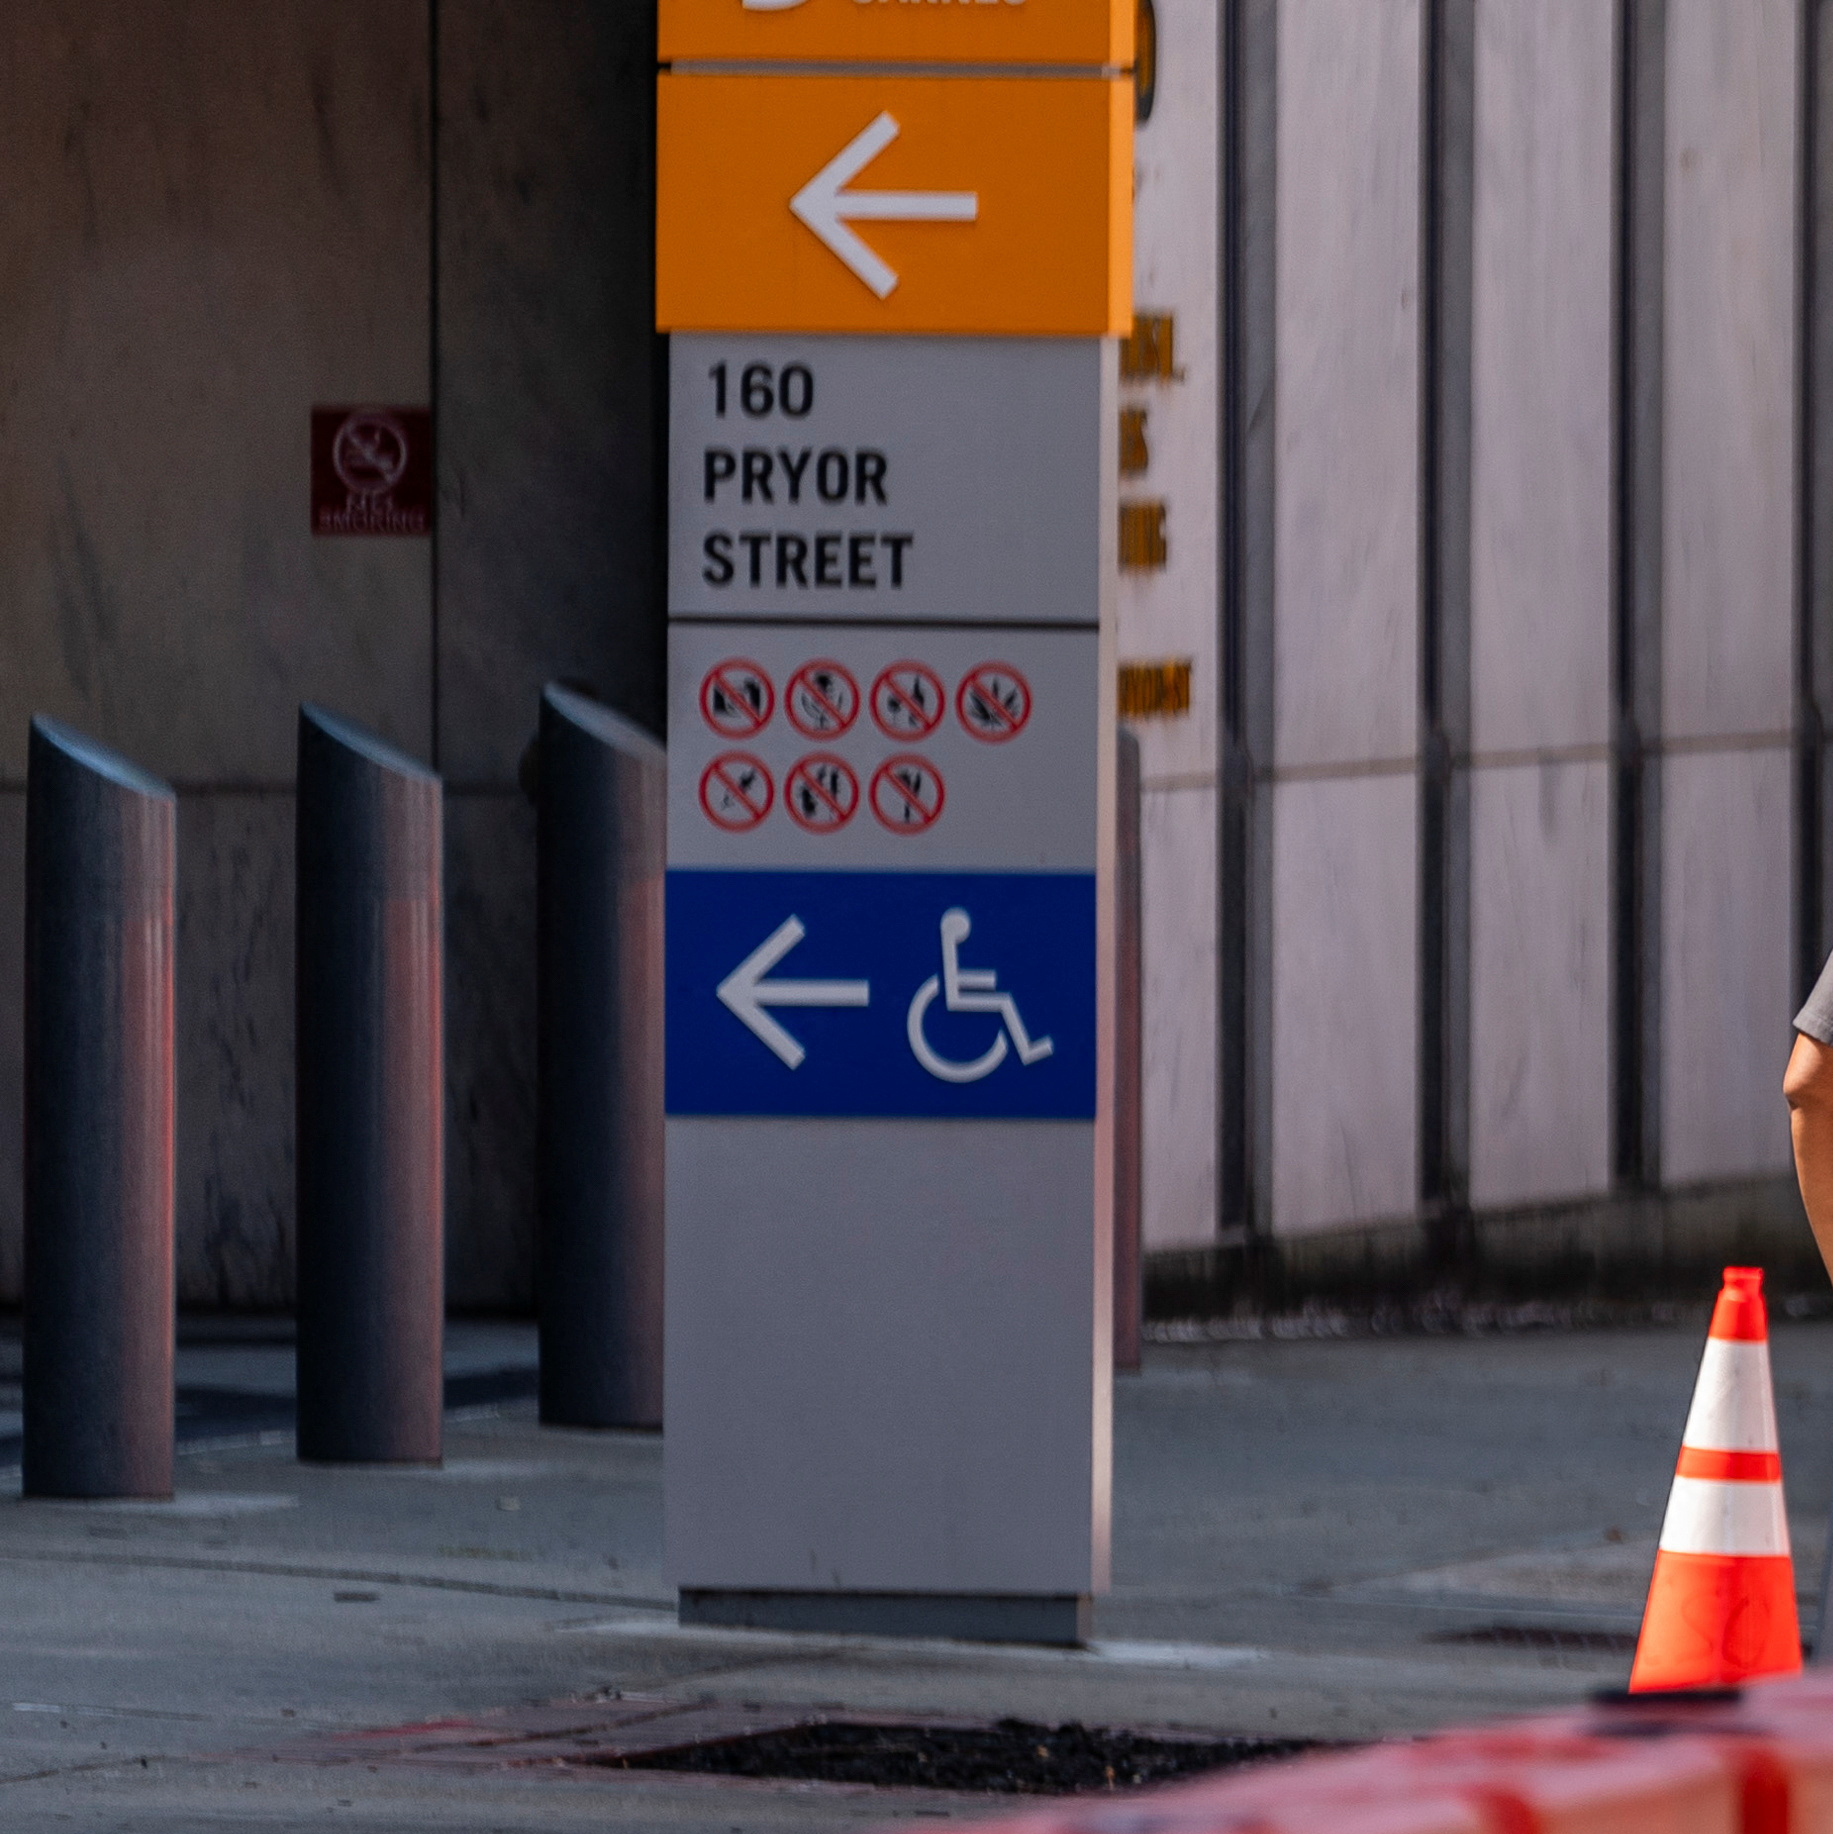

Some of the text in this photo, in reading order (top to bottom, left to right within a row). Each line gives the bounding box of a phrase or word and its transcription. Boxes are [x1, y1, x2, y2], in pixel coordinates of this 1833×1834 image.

[708, 361, 815, 419] 160
[703, 447, 888, 504] PRYOR
[702, 532, 914, 588] STREET
